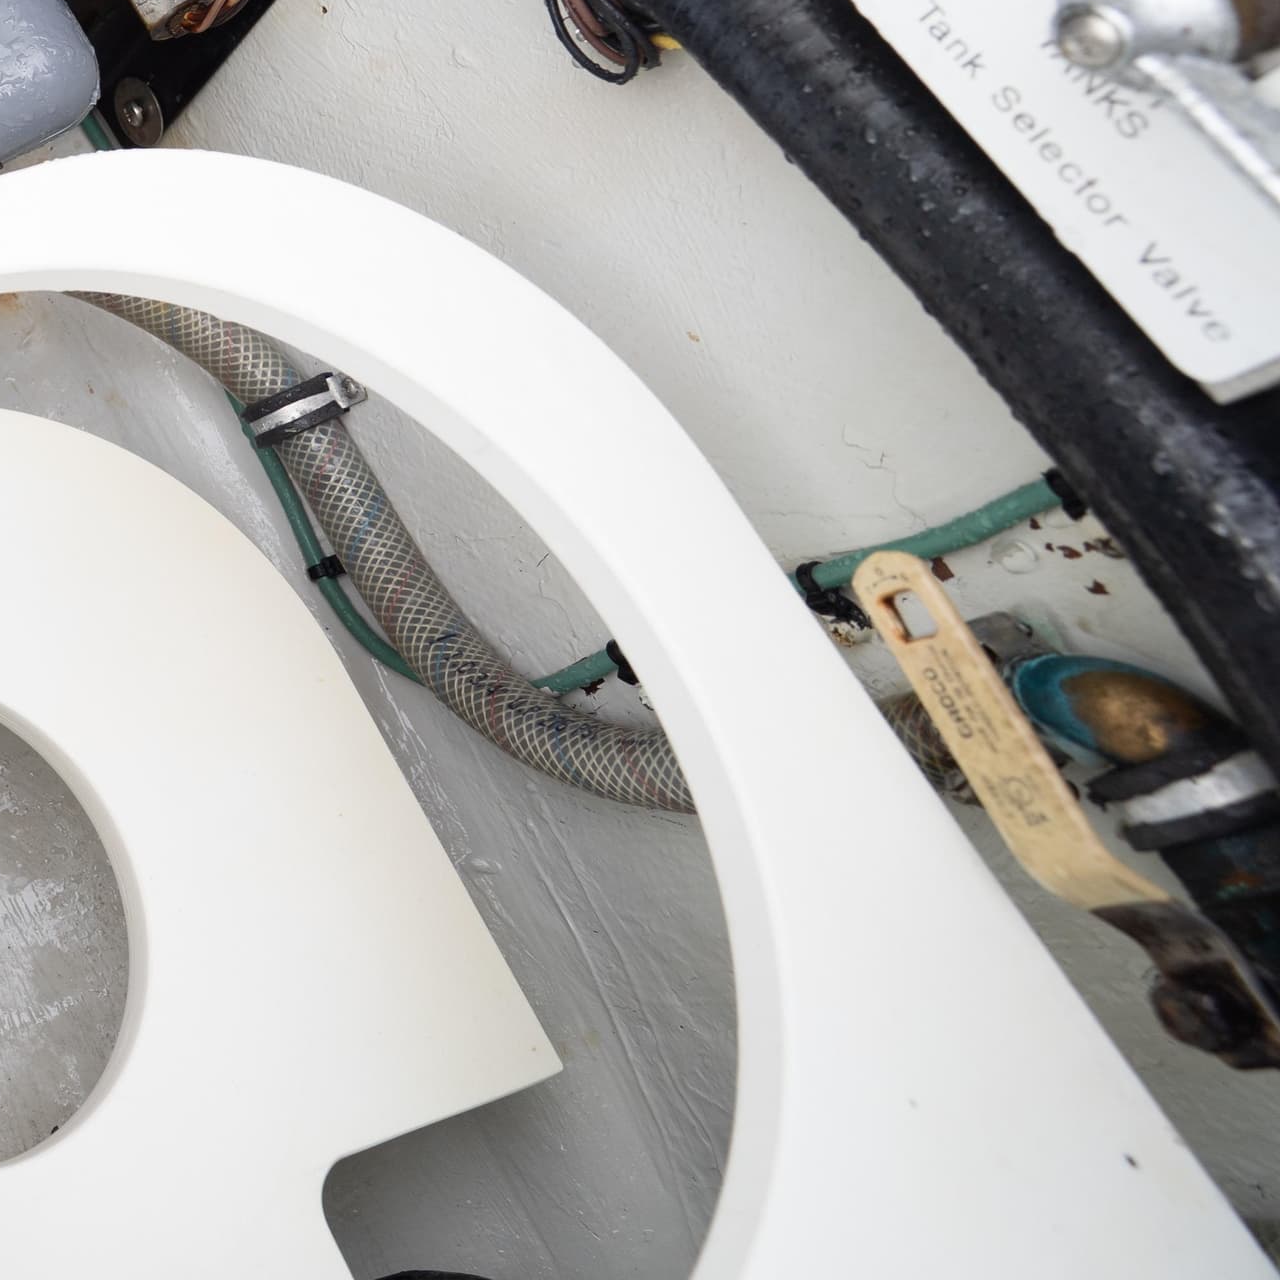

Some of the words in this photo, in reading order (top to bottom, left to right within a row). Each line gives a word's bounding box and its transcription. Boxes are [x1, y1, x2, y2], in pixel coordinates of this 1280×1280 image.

[917, 0, 987, 81] Tank
[991, 84, 1130, 229] Selector
[1137, 240, 1233, 345] Valve
